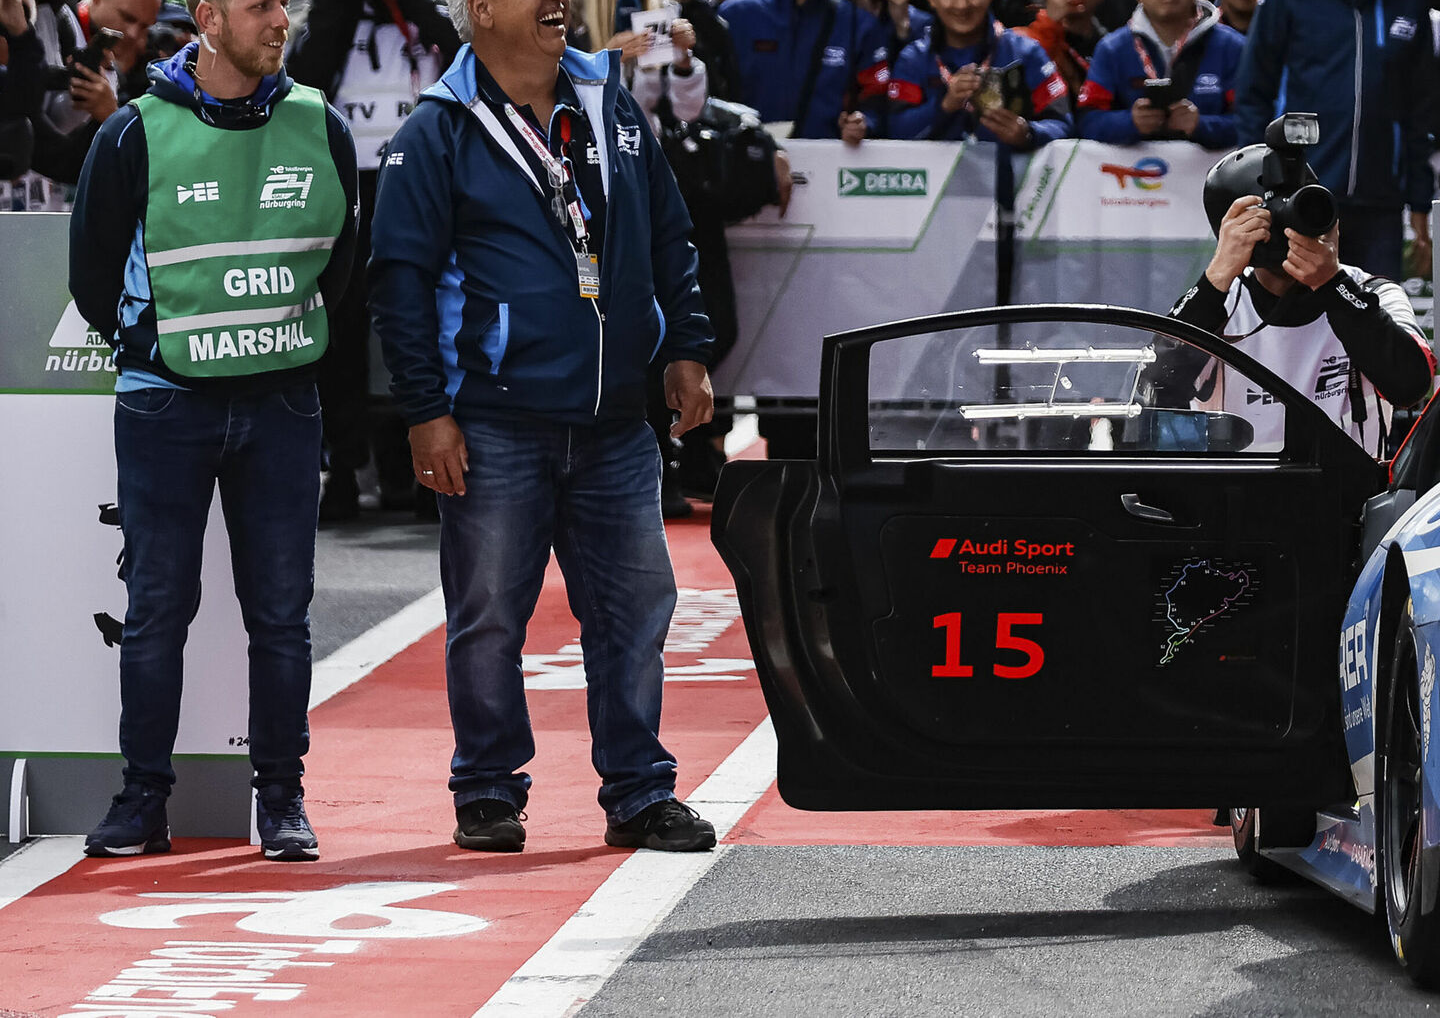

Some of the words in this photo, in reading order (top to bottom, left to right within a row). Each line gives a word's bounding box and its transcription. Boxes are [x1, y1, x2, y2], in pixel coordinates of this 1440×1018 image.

[864, 172, 924, 191] DEKRA
[259, 199, 306, 210] nürburgring
[223, 266, 295, 297] GRID
[188, 320, 314, 362] MARSHAL
[959, 539, 1008, 555] Audi
[1014, 539, 1075, 559] Sport
[959, 561, 1001, 574] Team
[1006, 562, 1068, 575] Phoenix
[931, 612, 1045, 679] 15
